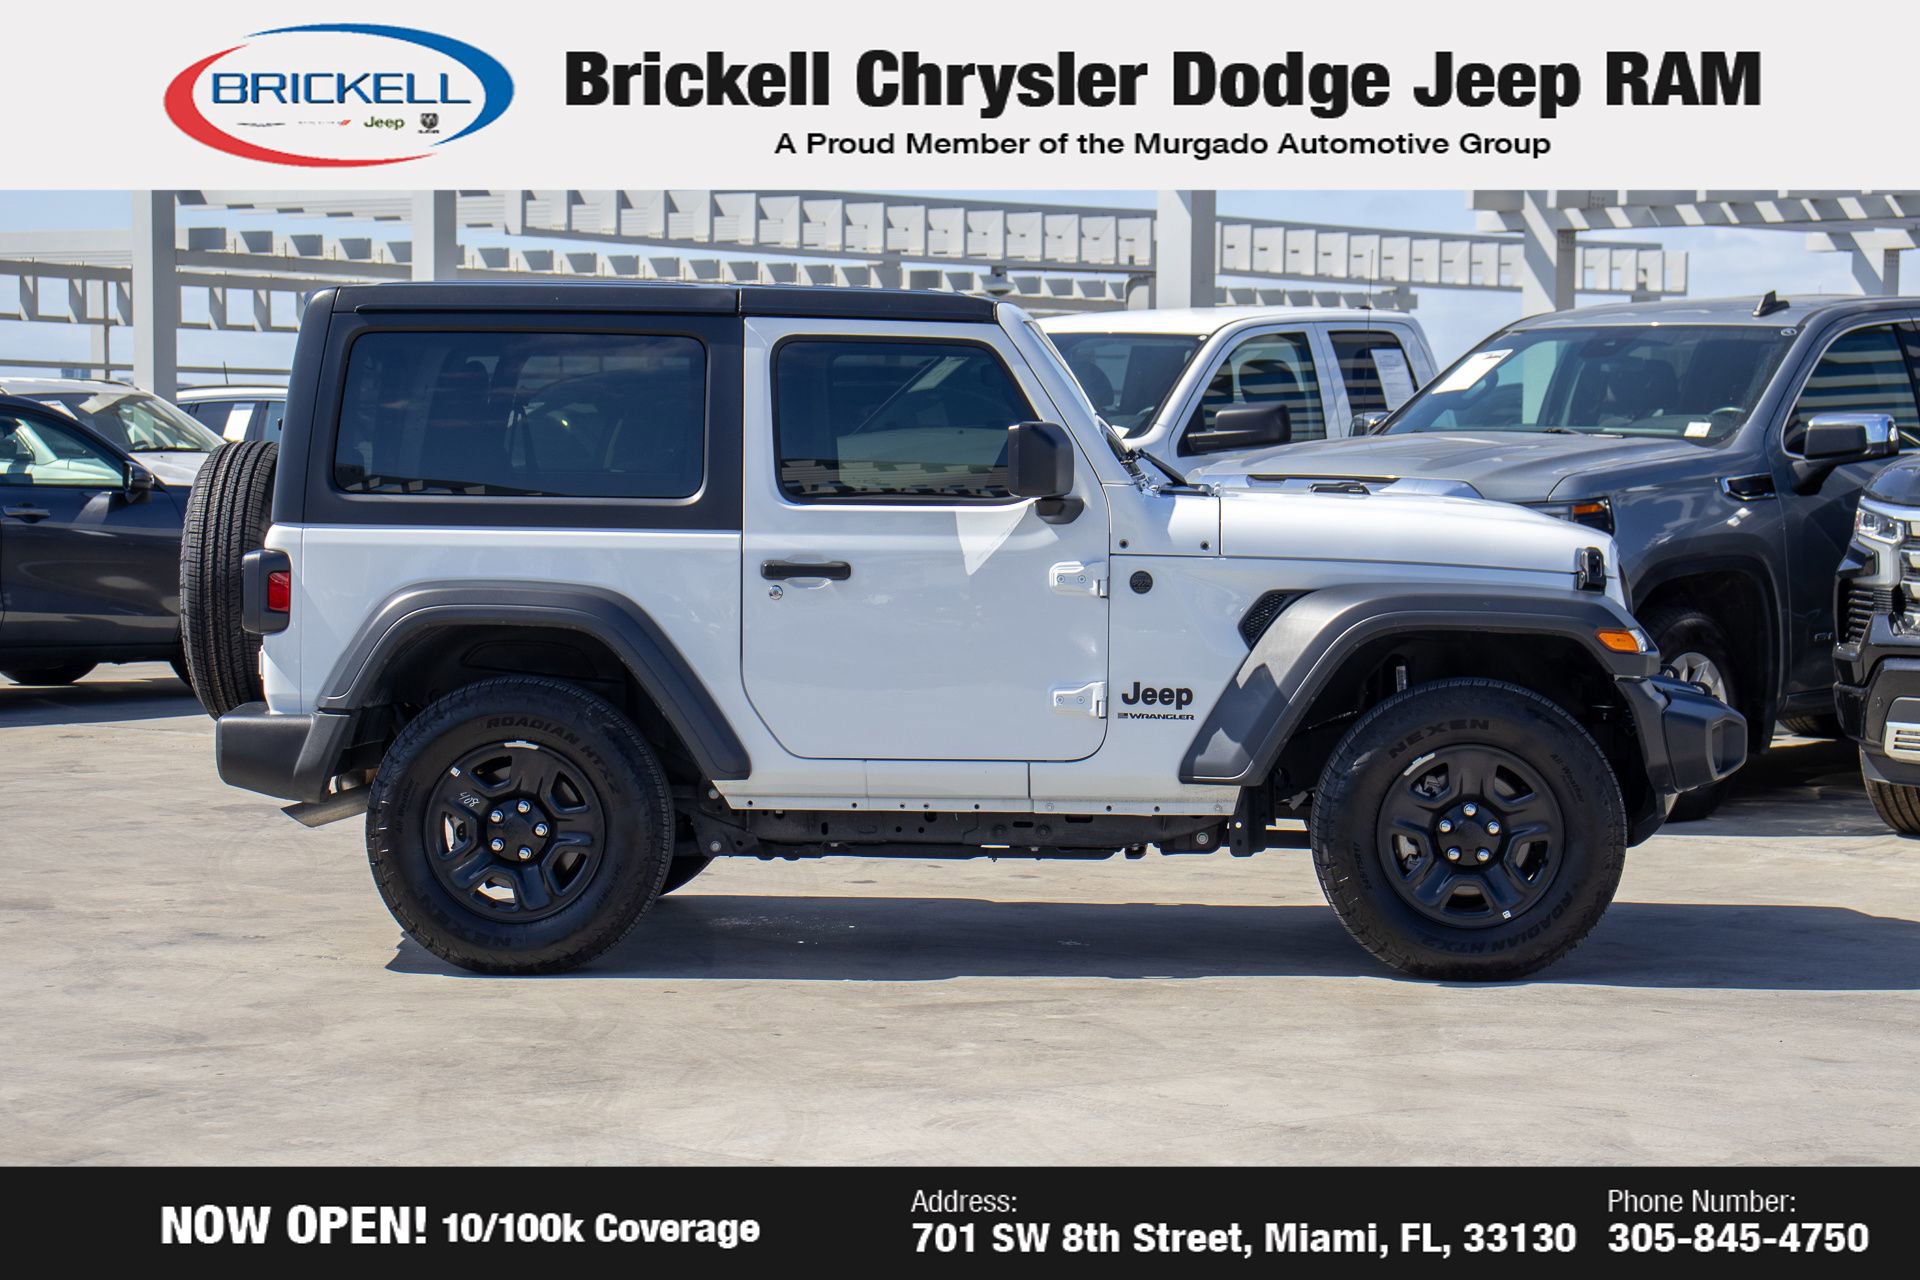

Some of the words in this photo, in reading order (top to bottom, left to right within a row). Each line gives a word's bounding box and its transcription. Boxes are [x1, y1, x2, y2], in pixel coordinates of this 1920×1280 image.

[1122, 682, 1193, 710] Jeep
[485, 715, 580, 745] ROADIAN
[1388, 718, 1490, 759] NEXEN
